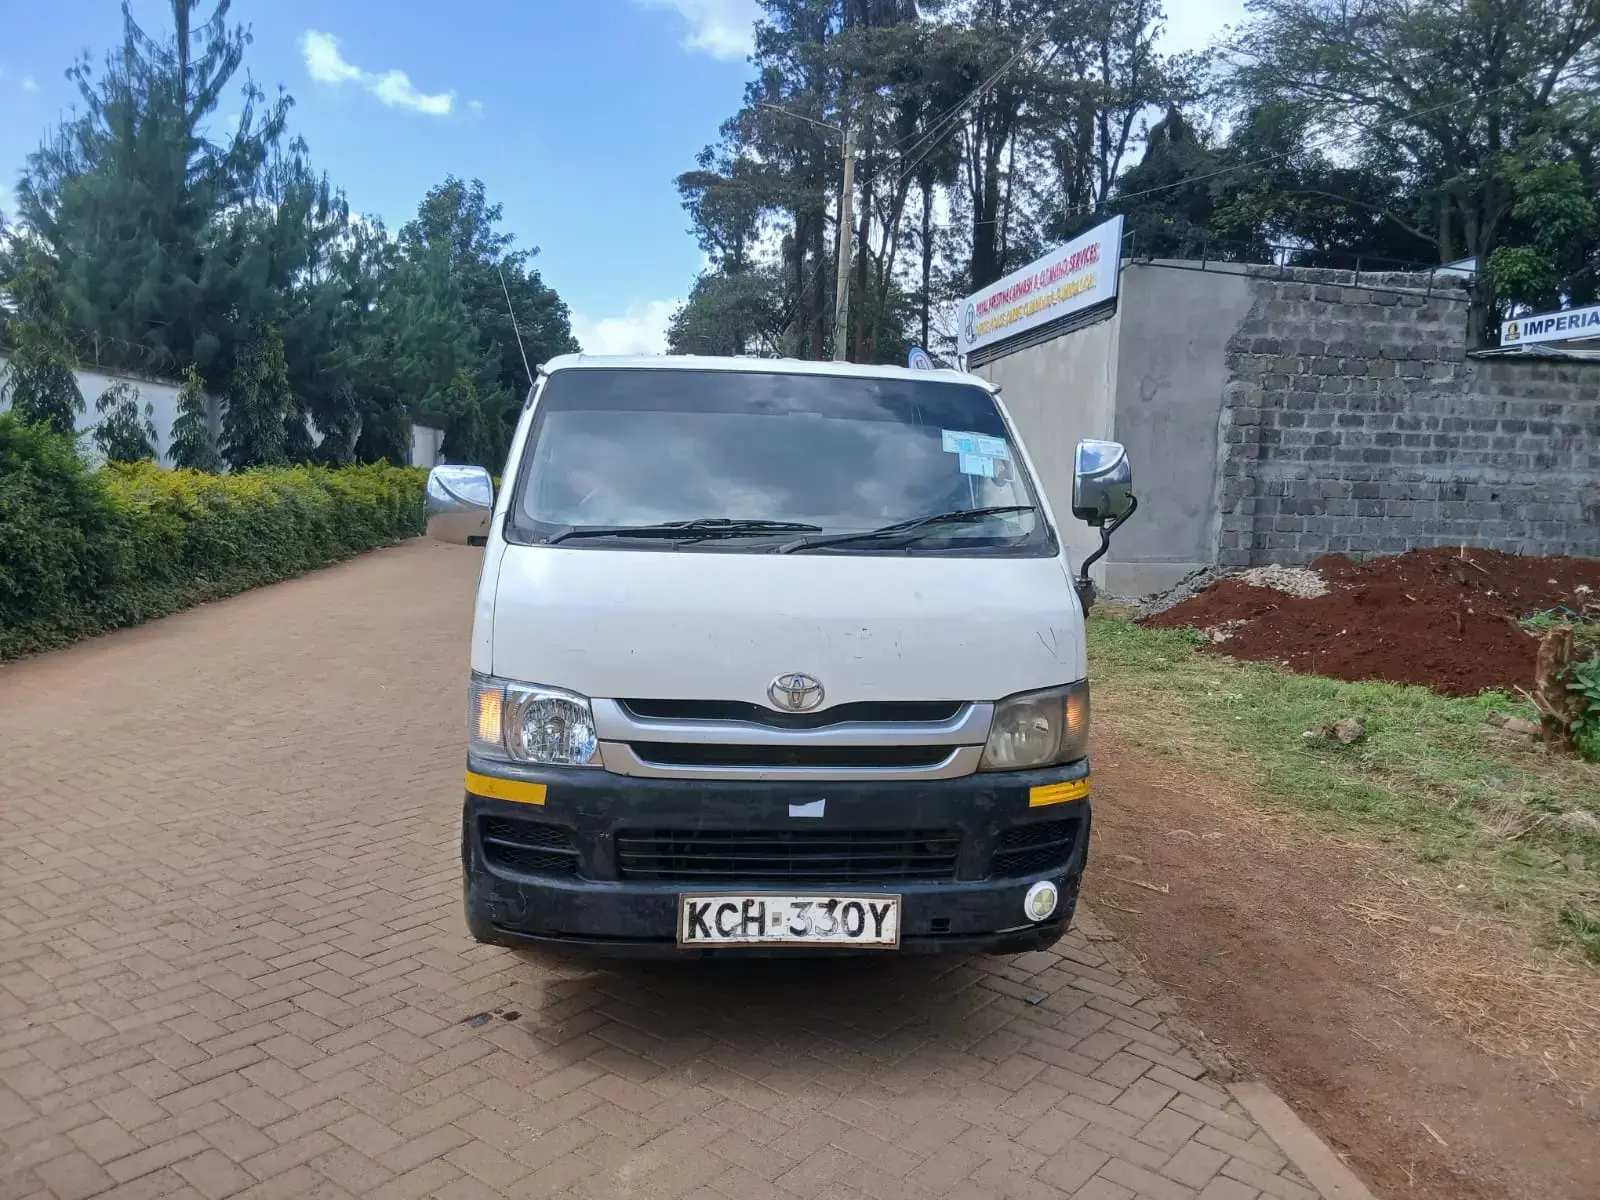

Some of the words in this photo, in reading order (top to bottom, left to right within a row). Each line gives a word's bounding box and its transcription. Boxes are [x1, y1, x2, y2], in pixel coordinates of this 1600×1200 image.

[1069, 242, 1100, 272] SERVICES
[1523, 311, 1600, 336] IMPERIA
[687, 900, 766, 939] KCH
[789, 900, 892, 938] 330Y
